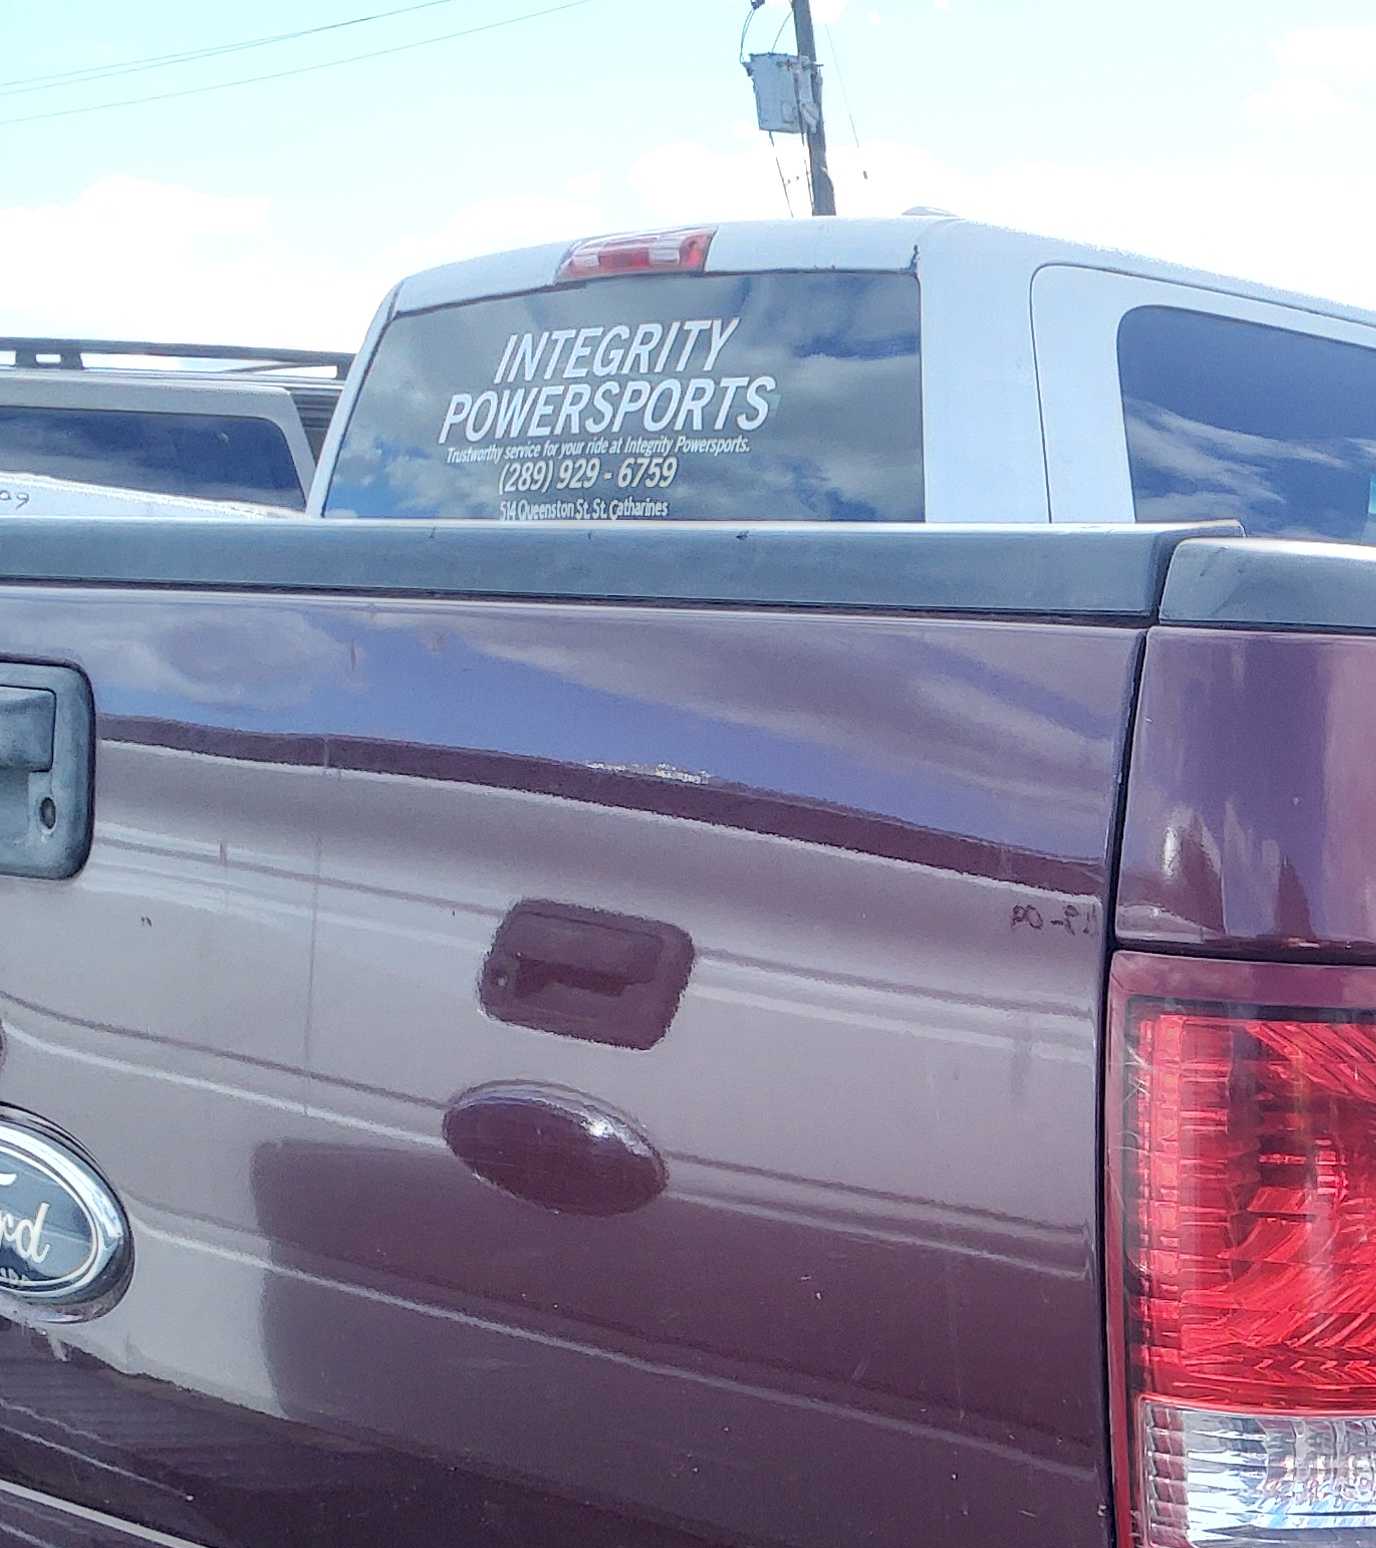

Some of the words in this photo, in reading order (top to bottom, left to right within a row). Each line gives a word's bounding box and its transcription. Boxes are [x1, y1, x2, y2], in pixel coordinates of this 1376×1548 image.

[493, 317, 742, 384] INTEGRITY
[438, 376, 778, 445] POWERSPORTS
[447, 444, 502, 464] Trustworthy
[504, 441, 540, 460] service
[543, 440, 560, 457] for
[559, 443, 584, 460] your
[586, 436, 609, 454] ride
[609, 437, 623, 454] at
[624, 434, 673, 456] Integrity
[675, 434, 751, 456] Powersports.
[499, 460, 554, 495] (289)
[556, 457, 601, 489] 929
[617, 456, 679, 488] 6759
[500, 499, 517, 520] 514
[517, 499, 576, 520] Queenston
[609, 496, 669, 520] Catharines
